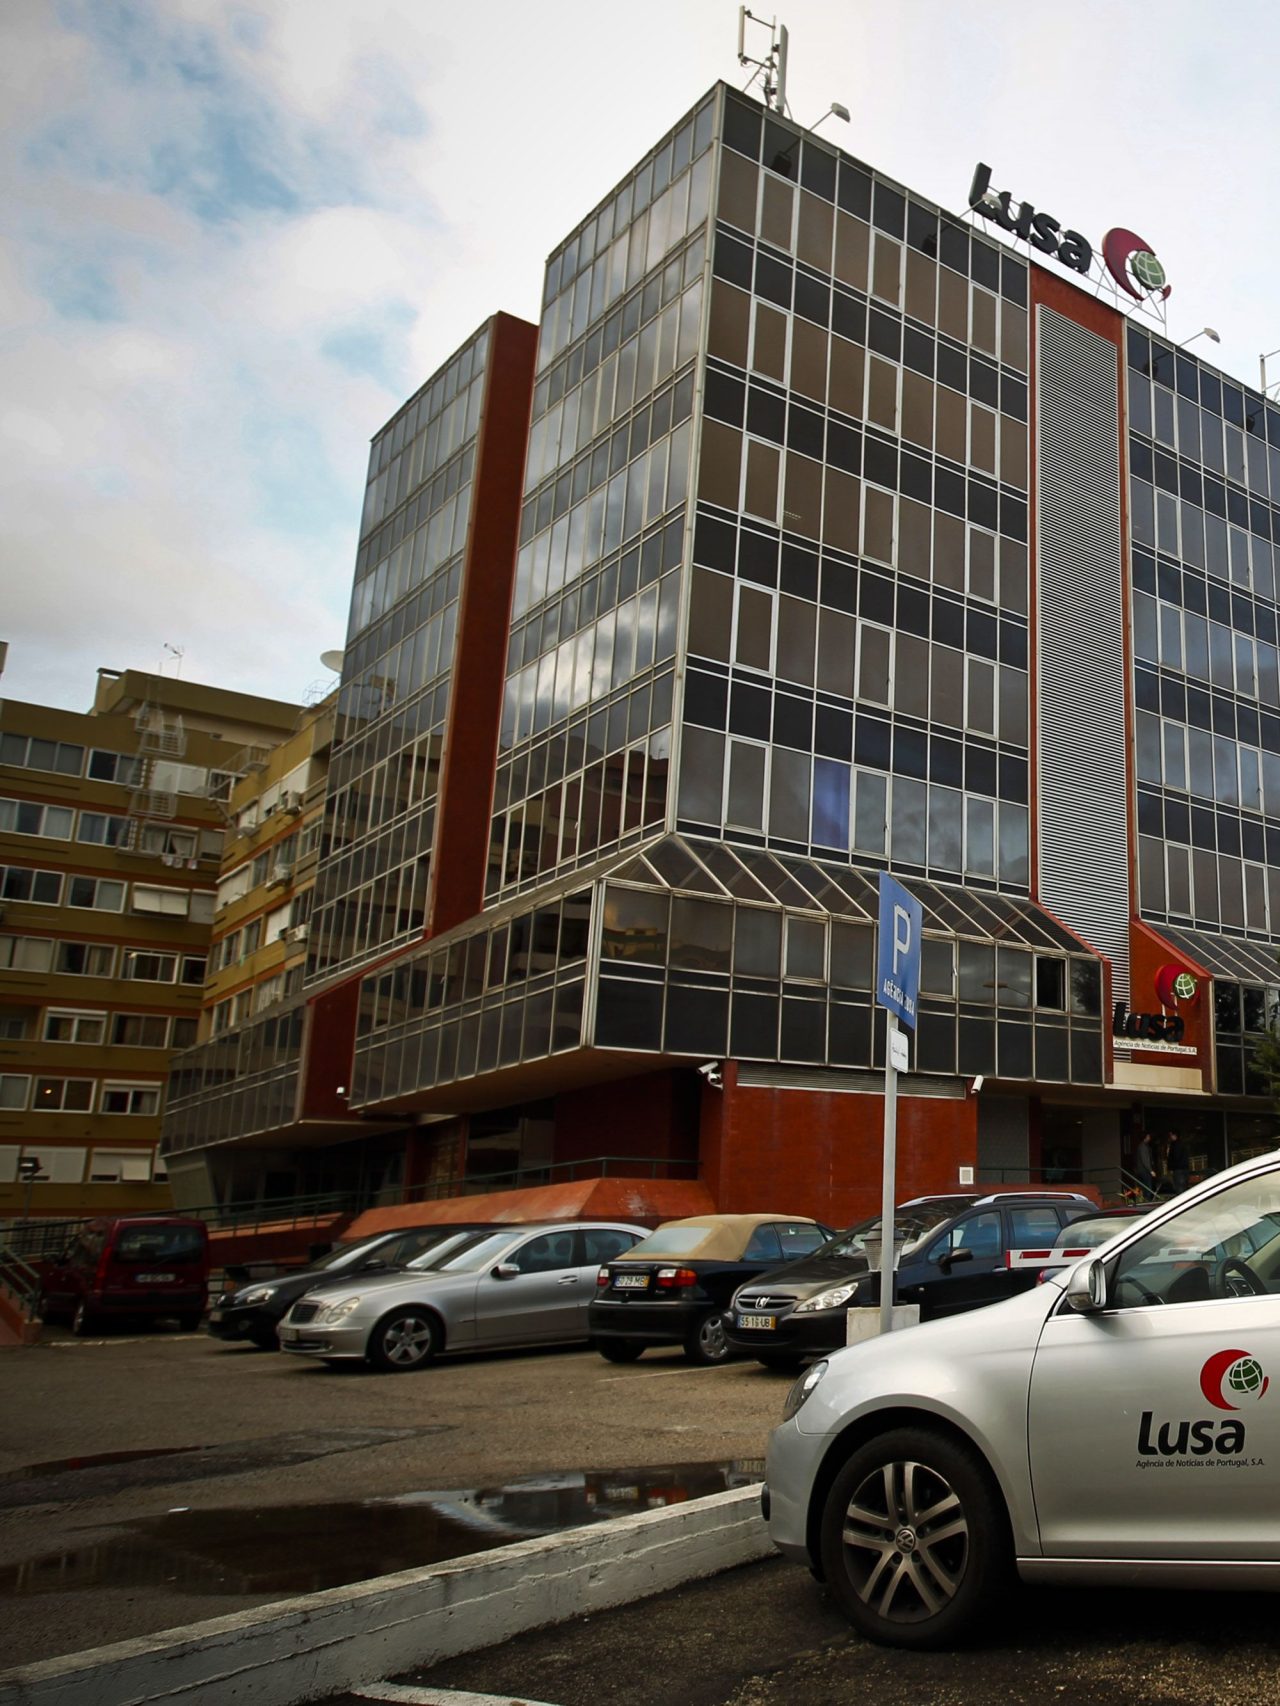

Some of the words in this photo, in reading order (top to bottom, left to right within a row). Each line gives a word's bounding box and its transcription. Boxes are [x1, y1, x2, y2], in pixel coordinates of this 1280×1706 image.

[968, 162, 1092, 274] Lusa
[893, 904, 911, 975] P
[1112, 1002, 1185, 1043] Lusa
[1138, 1411, 1246, 1456] Lusa
[1136, 1458, 1164, 1470] Agência
[1165, 1459, 1175, 1468] de
[1205, 1457, 1215, 1467] de
